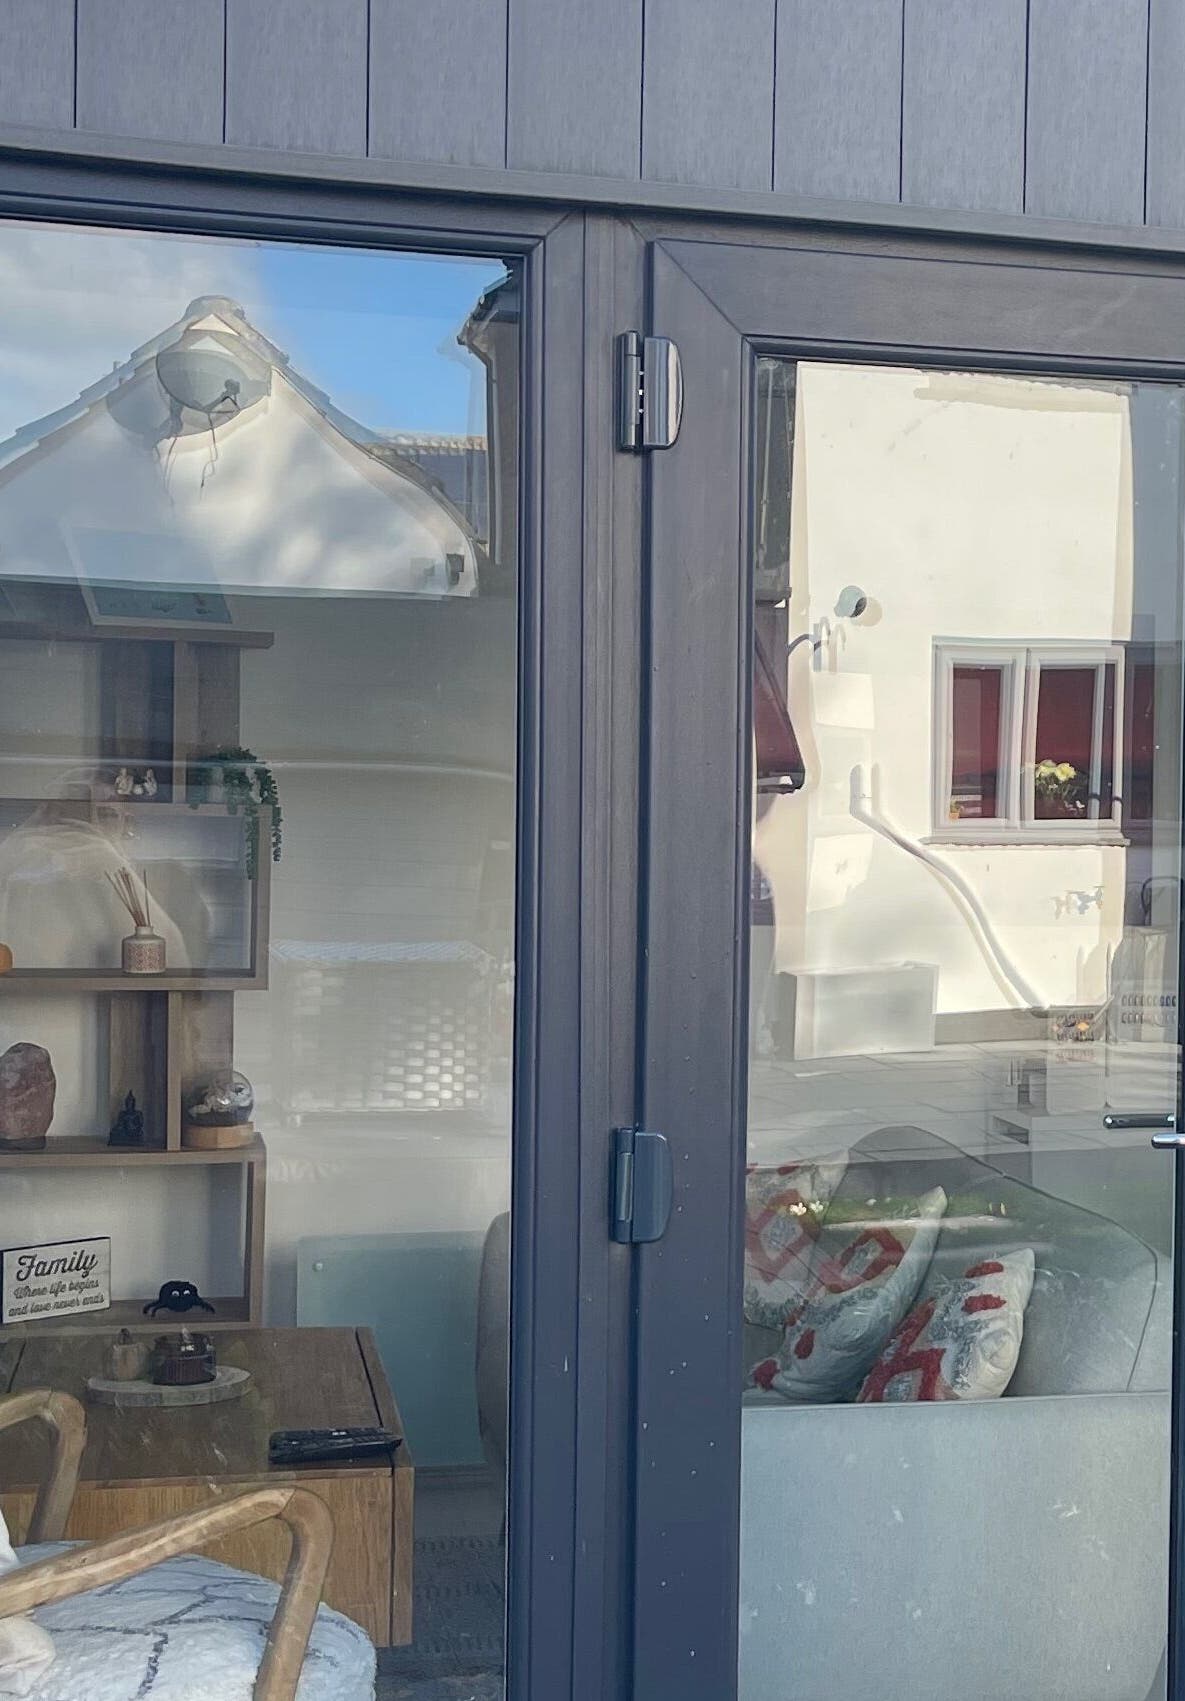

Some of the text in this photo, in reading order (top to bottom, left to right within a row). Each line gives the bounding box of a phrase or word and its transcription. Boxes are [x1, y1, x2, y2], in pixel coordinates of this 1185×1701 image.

[16, 1249, 98, 1281] Family
[14, 1279, 99, 1299] Where life begins
[8, 1294, 105, 1316] and love never ends
